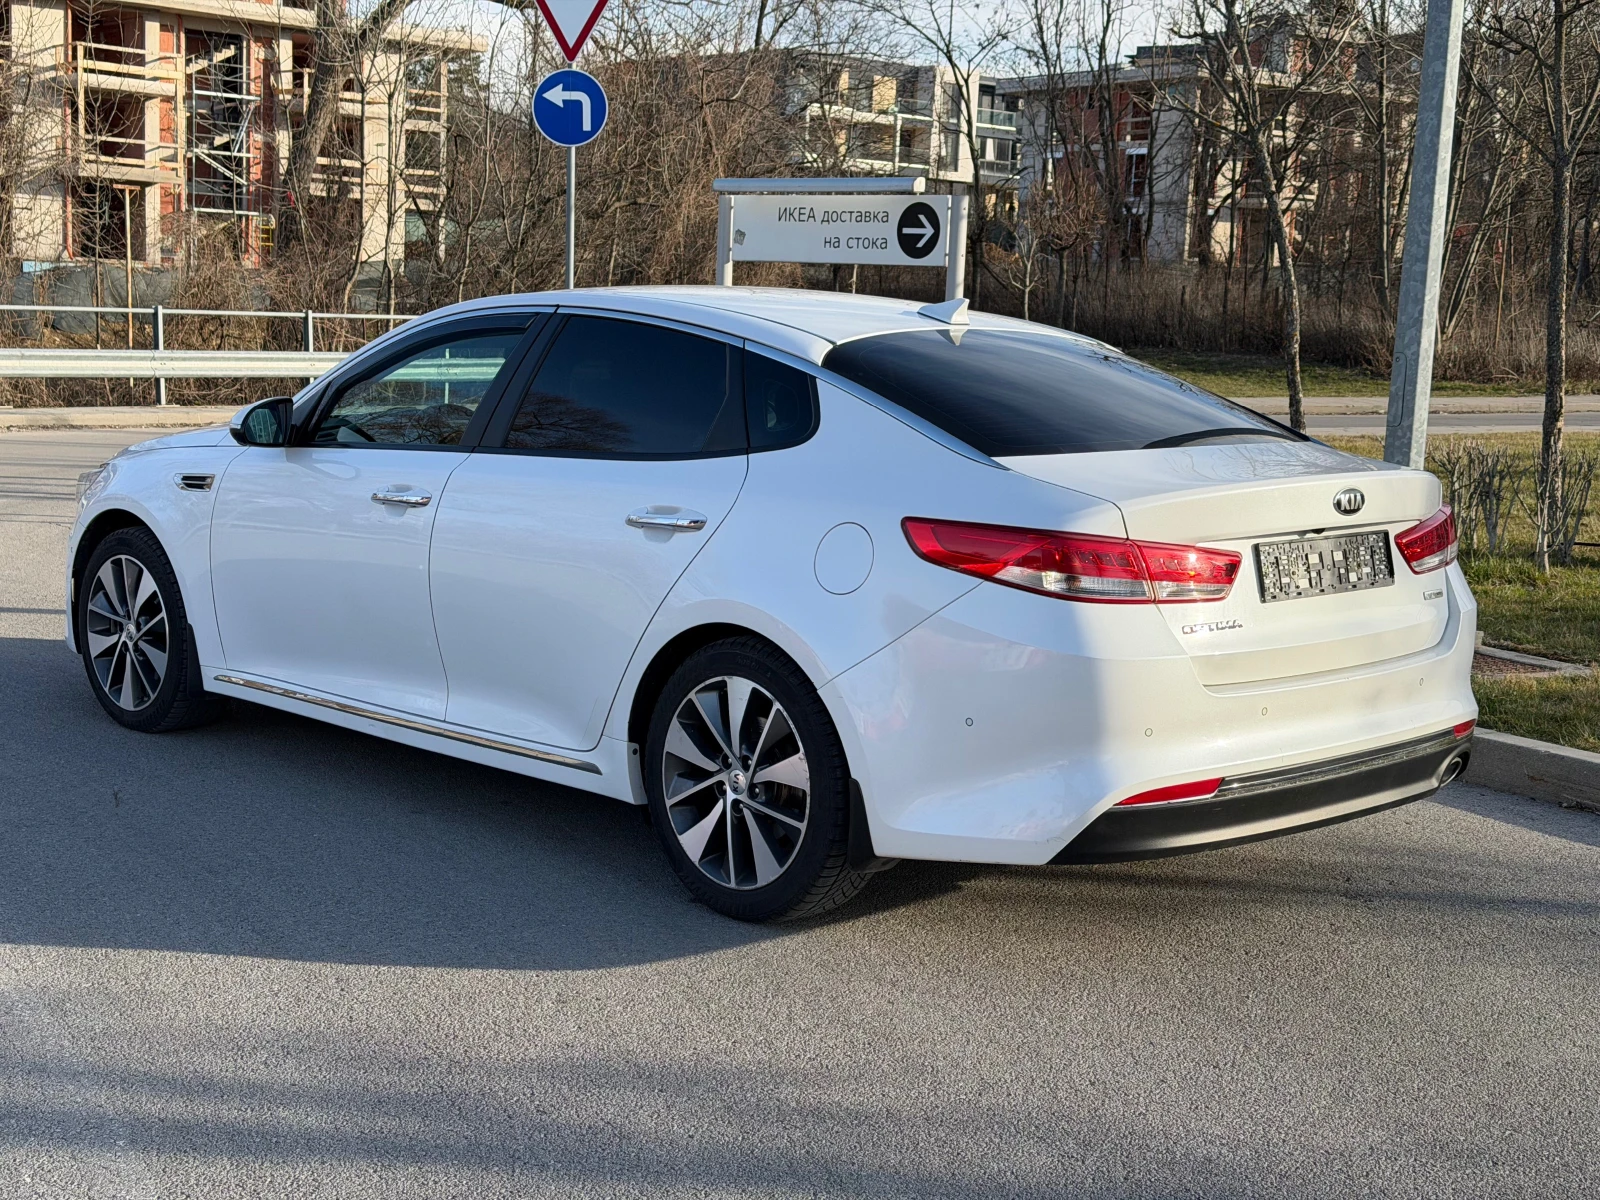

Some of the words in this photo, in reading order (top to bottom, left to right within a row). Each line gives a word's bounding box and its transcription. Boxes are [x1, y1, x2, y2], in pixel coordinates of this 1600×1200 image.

[778, 207, 817, 222] ИКЕА
[820, 210, 889, 225] доставка
[823, 236, 841, 249] на
[846, 236, 888, 250] стока
[1340, 492, 1363, 511] KIA
[732, 773, 744, 792] KIA
